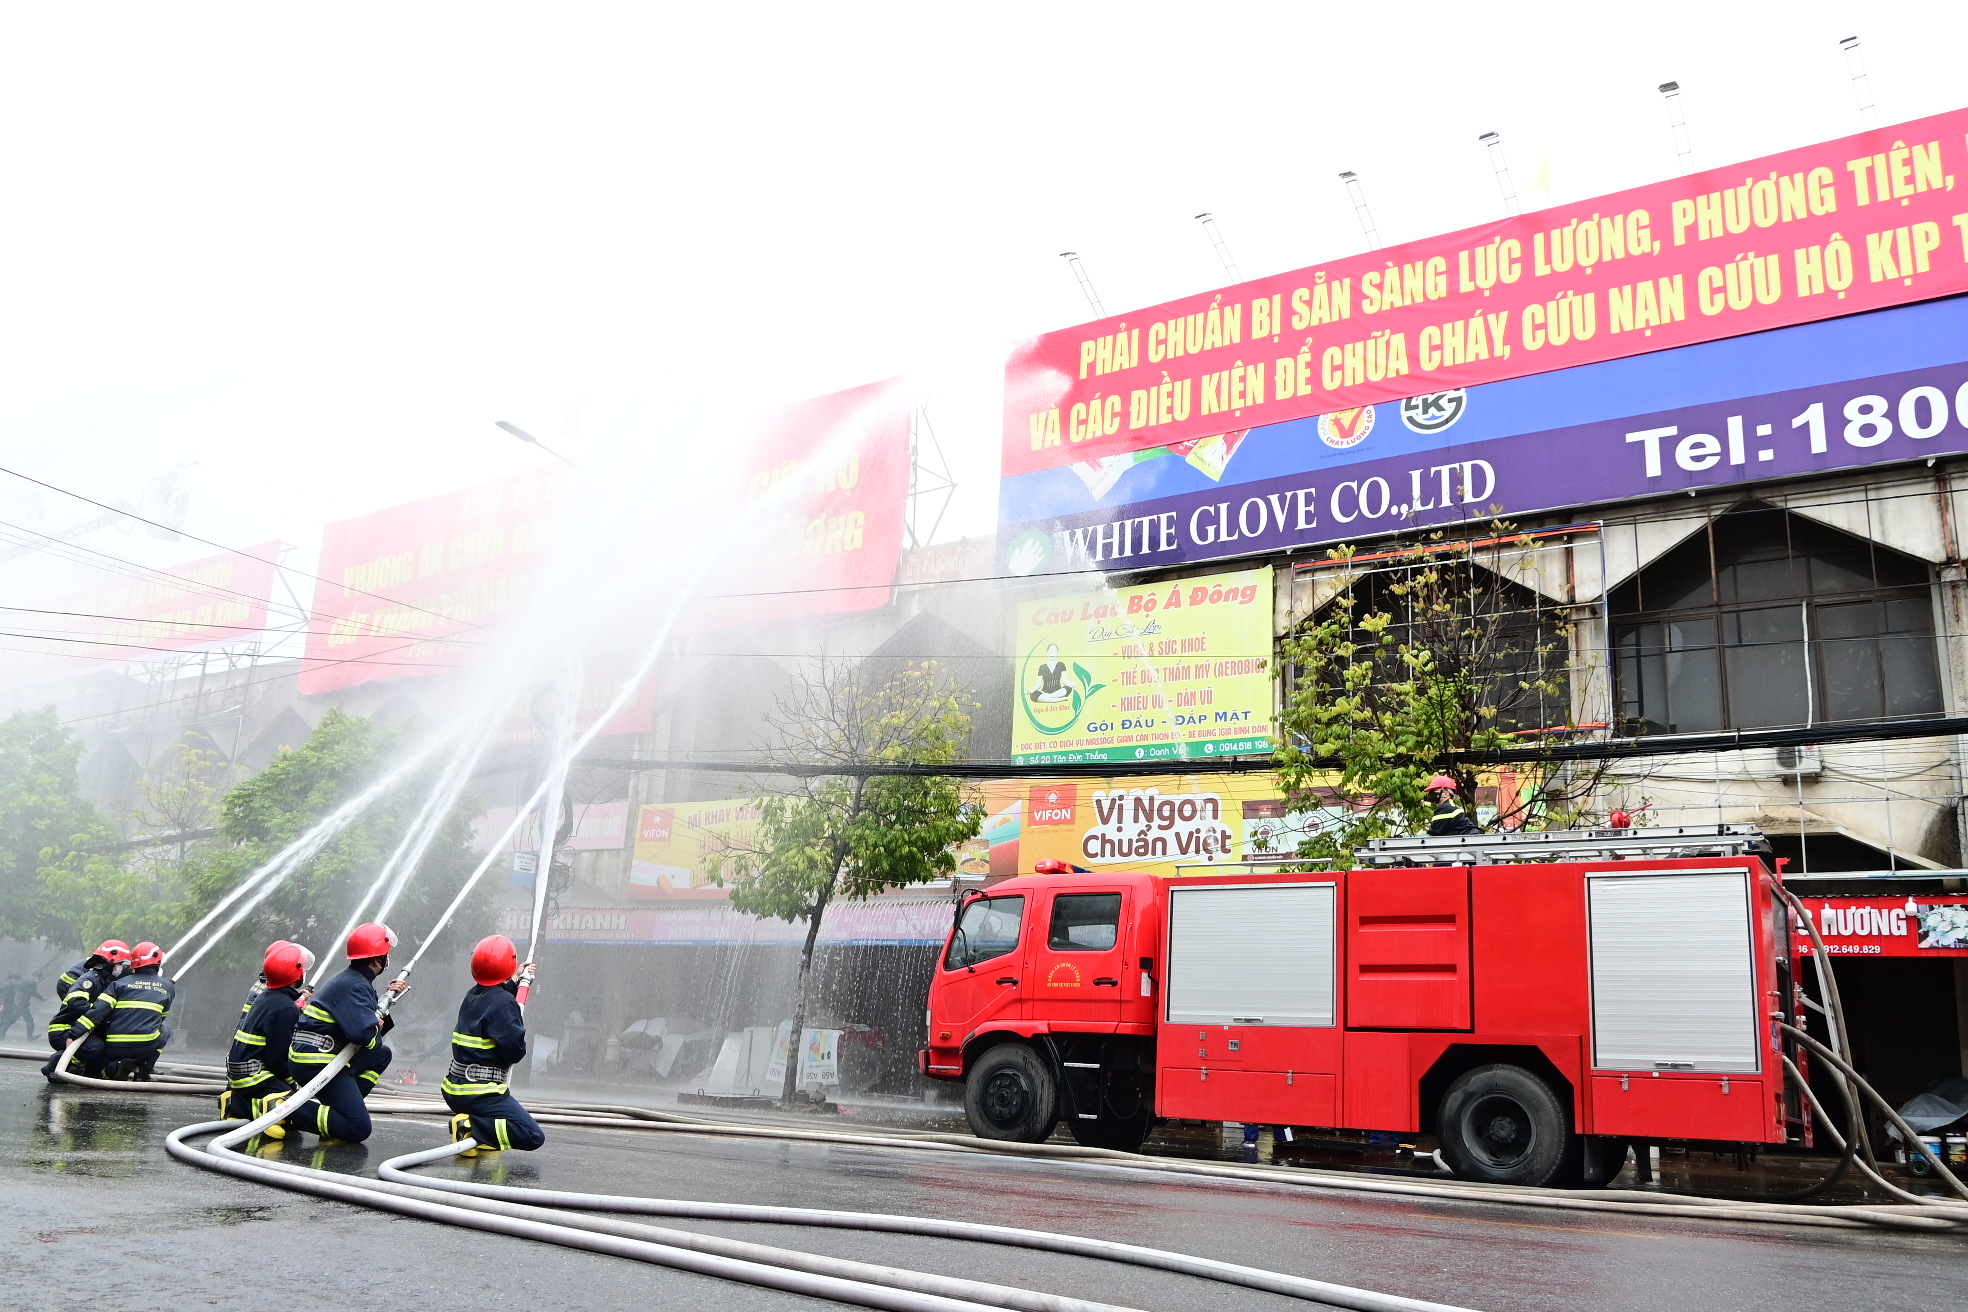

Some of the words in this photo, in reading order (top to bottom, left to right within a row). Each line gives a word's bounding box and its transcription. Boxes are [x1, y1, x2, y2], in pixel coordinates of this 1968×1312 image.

[1079, 323, 1140, 380] PHẢI
[1147, 297, 1242, 363] CHUẨN
[1251, 293, 1281, 343] BỊ
[1292, 270, 1352, 330] SẴN
[1361, 253, 1448, 314] SÀNG
[1458, 236, 1522, 297] LỰC
[1533, 209, 1661, 278] LƯỢNG,
[1672, 166, 1836, 247] PHƯƠNG
[1846, 139, 1955, 208] TIỆN,
[1029, 402, 1063, 452] VÀ
[1068, 391, 1122, 443] CÁC
[1129, 370, 1191, 430] ĐIỀU
[1200, 359, 1266, 418] KIỆN
[1274, 337, 1313, 394] ĐỂ
[1321, 330, 1410, 391] CHỮA
[1418, 309, 1511, 372] CHÁY,
[1521, 291, 1596, 351] CỨU
[1608, 273, 1686, 337] NẠN
[1698, 252, 1782, 316] CỨU
[1794, 232, 1854, 300] HỘ
[1866, 220, 1941, 288] KỊP
[1791, 384, 1968, 455] 180
[1062, 510, 1179, 567] WHITE
[1189, 486, 1318, 548] GLOVE
[1330, 459, 1497, 525] CO.,LTD
[343, 550, 413, 599] PHƯƠNG
[418, 541, 444, 579] ÁN
[1080, 601, 1121, 625] Lạc
[1127, 592, 1157, 619] Bộ
[1163, 583, 1182, 609] Á
[1189, 583, 1258, 607] Đông
[1158, 637, 1178, 656] SỨC
[1120, 663, 1138, 687] THỂ
[1163, 659, 1191, 683] THẨM
[1195, 659, 1211, 680] MỸ
[1176, 687, 1197, 708] DÂN
[1087, 719, 1115, 735] GỘI
[1120, 715, 1155, 730] ĐẦU
[1174, 710, 1208, 726] ĐẮP
[1086, 736, 1115, 746] MASSAGE
[1149, 747, 1169, 756] Oanh
[1041, 755, 1050, 763] 20
[704, 809, 732, 826] KHAY
[1033, 808, 1072, 821] VIFON
[1095, 794, 1125, 834] Vị
[1133, 794, 1220, 831] Ngon
[643, 828, 669, 839] VIFON
[1082, 823, 1169, 859] Chuẩn
[1175, 825, 1233, 862] Việt
